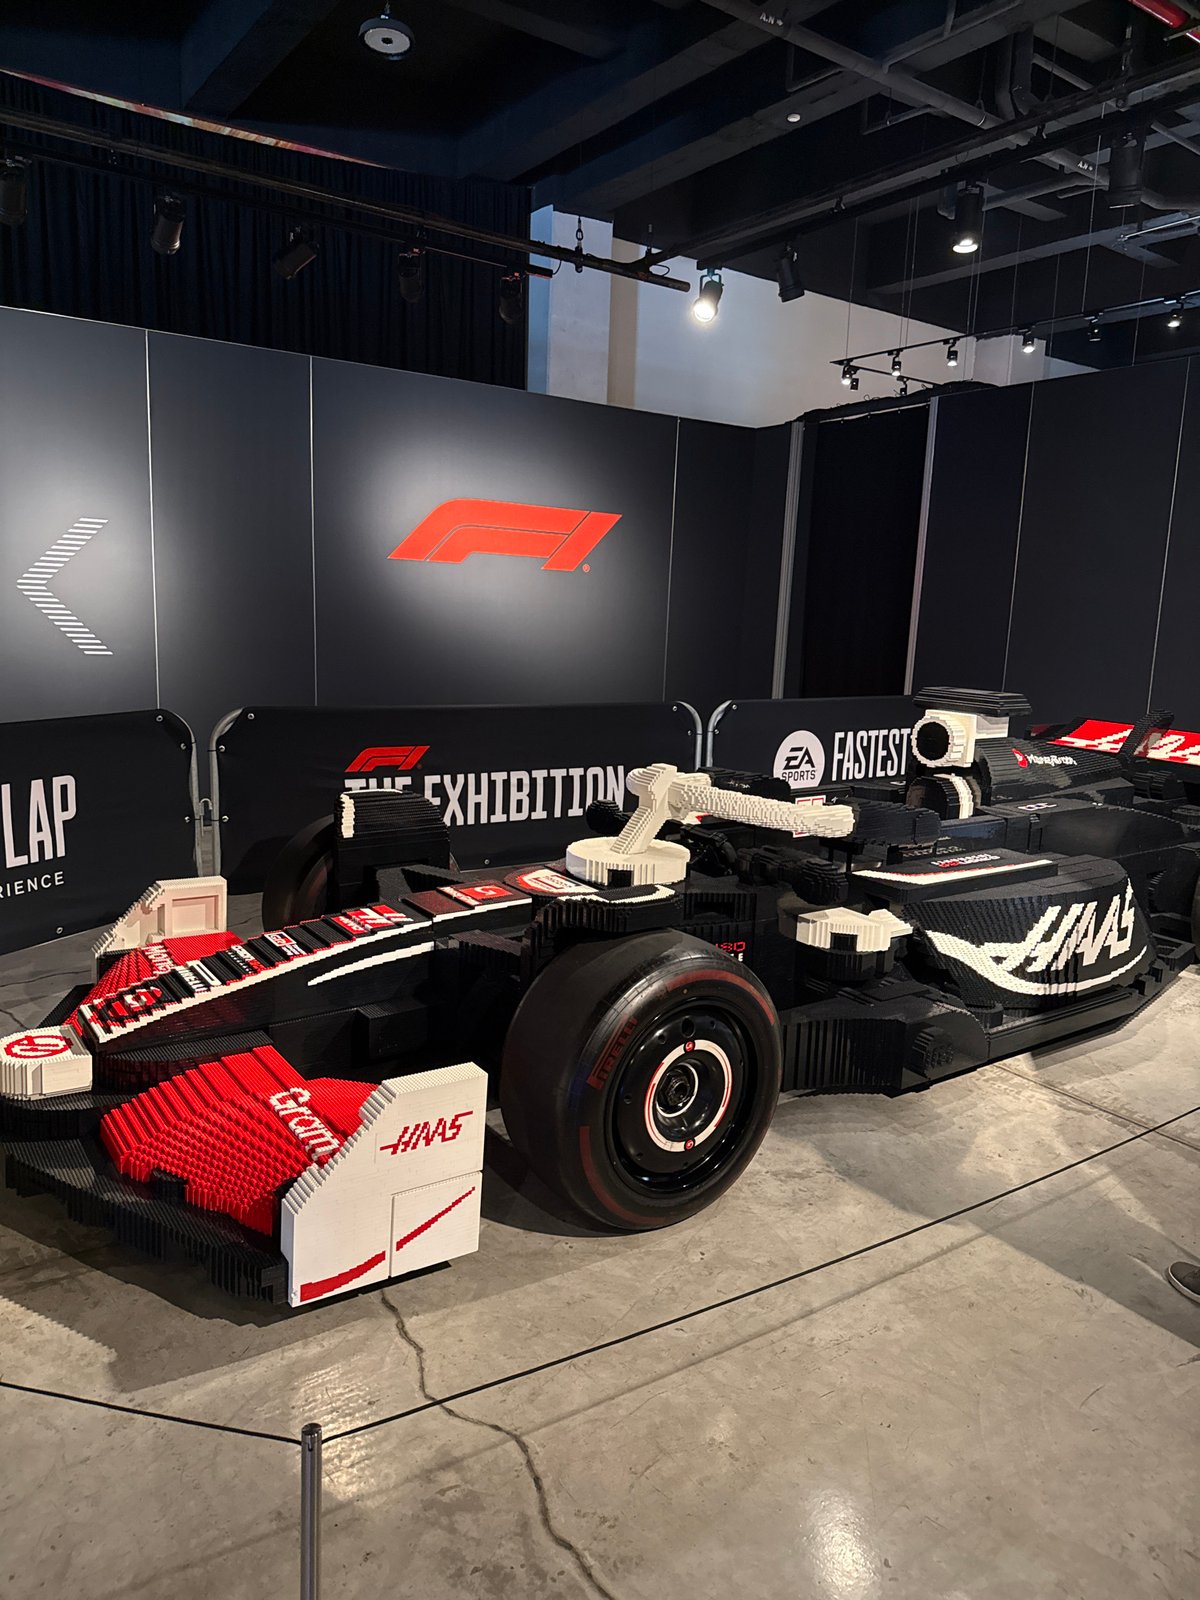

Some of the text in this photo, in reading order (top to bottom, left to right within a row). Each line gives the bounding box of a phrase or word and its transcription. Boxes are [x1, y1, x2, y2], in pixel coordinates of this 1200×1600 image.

[781, 769, 816, 781] SPORTS
[783, 746, 816, 770] EA
[831, 728, 911, 781] FASTEST
[1, 774, 77, 869] LAP
[424, 765, 625, 826] EXHIBITION
[988, 878, 1136, 971] HAAS
[269, 1087, 341, 1161] Gram
[380, 1110, 474, 1156] HAAS
